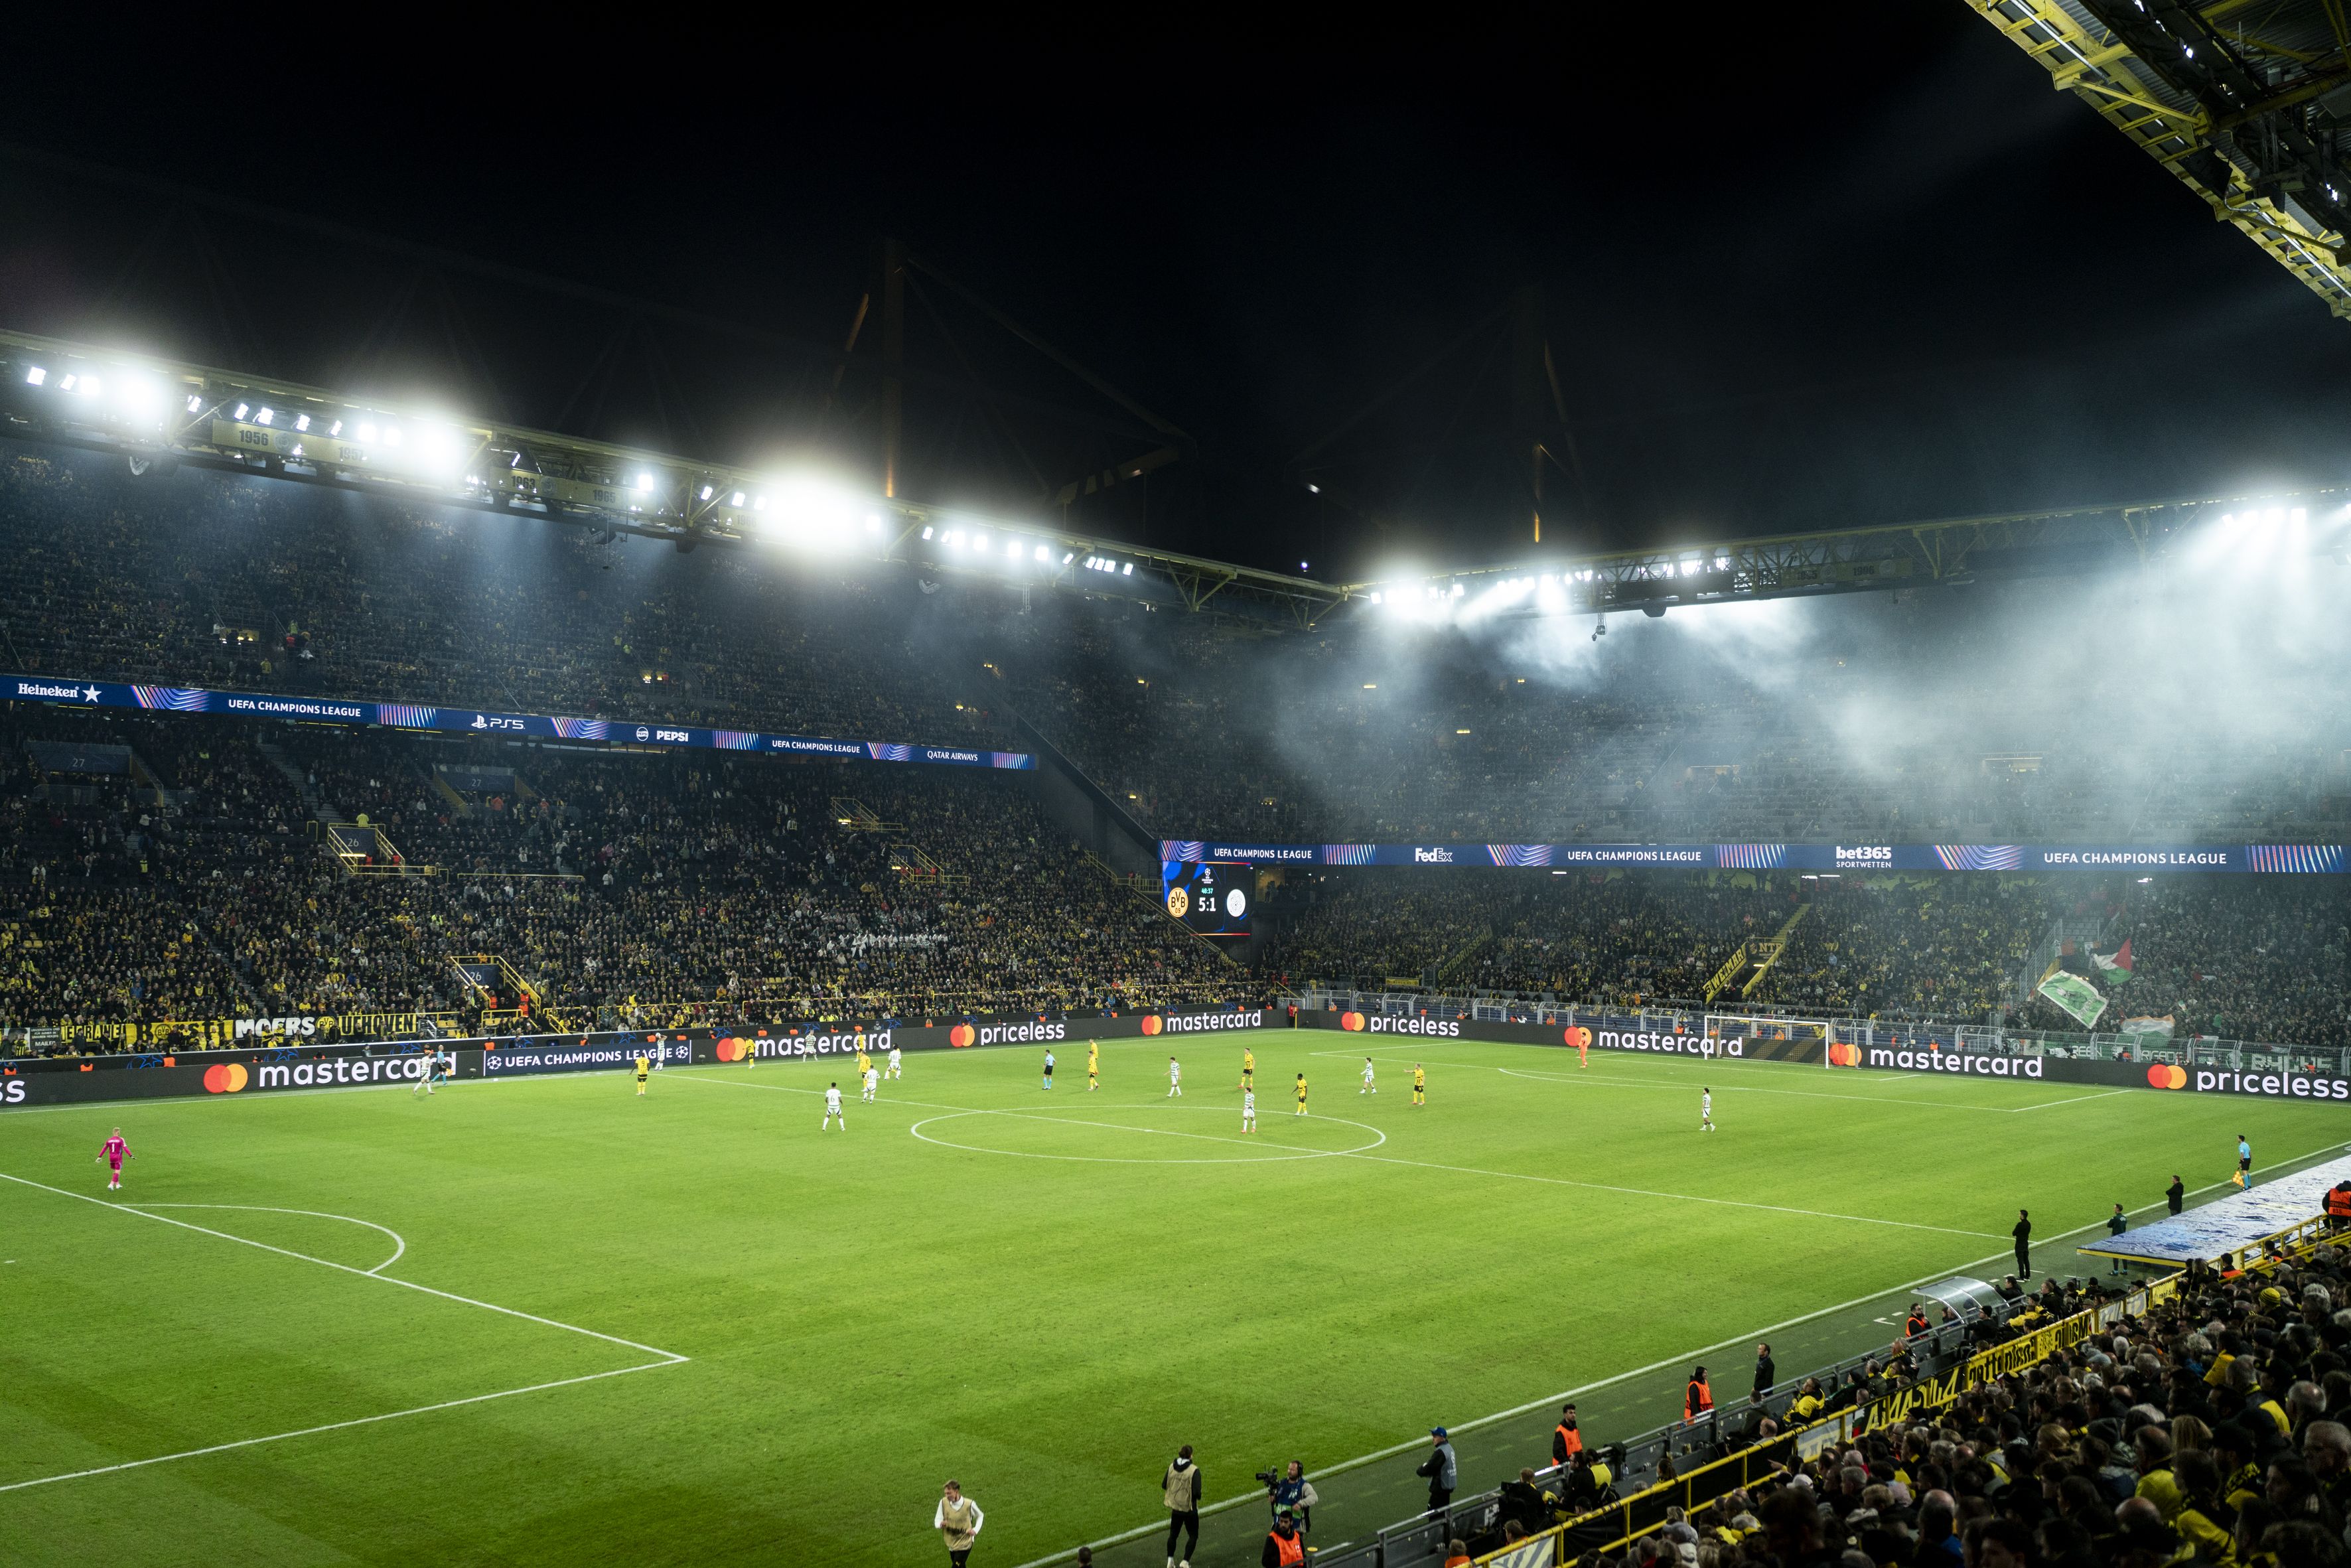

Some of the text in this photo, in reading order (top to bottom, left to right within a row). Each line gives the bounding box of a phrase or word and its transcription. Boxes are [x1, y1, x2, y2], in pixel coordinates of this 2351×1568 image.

[239, 429, 269, 446] 1956
[512, 475, 535, 489] 1963
[593, 489, 616, 503] 1965
[19, 683, 78, 697] Heineken
[228, 699, 361, 717] UEFA CHAMPIONS LEAGUE
[490, 718, 524, 730] PS5
[656, 730, 689, 742] PEPSI
[772, 740, 790, 748] UEFA
[792, 741, 833, 752] CHAMPIONS
[72, 758, 85, 767] 27
[927, 750, 978, 762] QATAR AIRWAYS
[470, 778, 481, 788] 27
[348, 838, 360, 847] 26
[1214, 848, 1312, 859] UEFA CHAMPIONS LEAGUE
[1415, 847, 1453, 863] FedEx
[1567, 851, 1701, 861] UEFA CHAMPIONS LEAGUE
[1836, 846, 1891, 859] bet365
[2044, 853, 2227, 864] UEFA CHAMPIONS LEAGUE
[1171, 891, 1186, 908] BVB
[1198, 897, 1216, 912] 5:1
[470, 971, 482, 981] 26
[1711, 948, 1745, 990] WEIMAR
[1167, 1009, 1261, 1032] mastercard
[1370, 1015, 1459, 1037] priceless
[981, 1021, 1065, 1046] priceless
[755, 1029, 891, 1058] masercard
[1599, 1031, 1743, 1056] mastercard
[505, 1048, 673, 1068] UEFA CHAMPIONS LEAGE
[1870, 1047, 2042, 1078] mastercard
[259, 1051, 457, 1087] mastercad
[2197, 1068, 2349, 1099] priceless
[0, 1080, 25, 1103] s
[111, 1143, 115, 1153] 1
